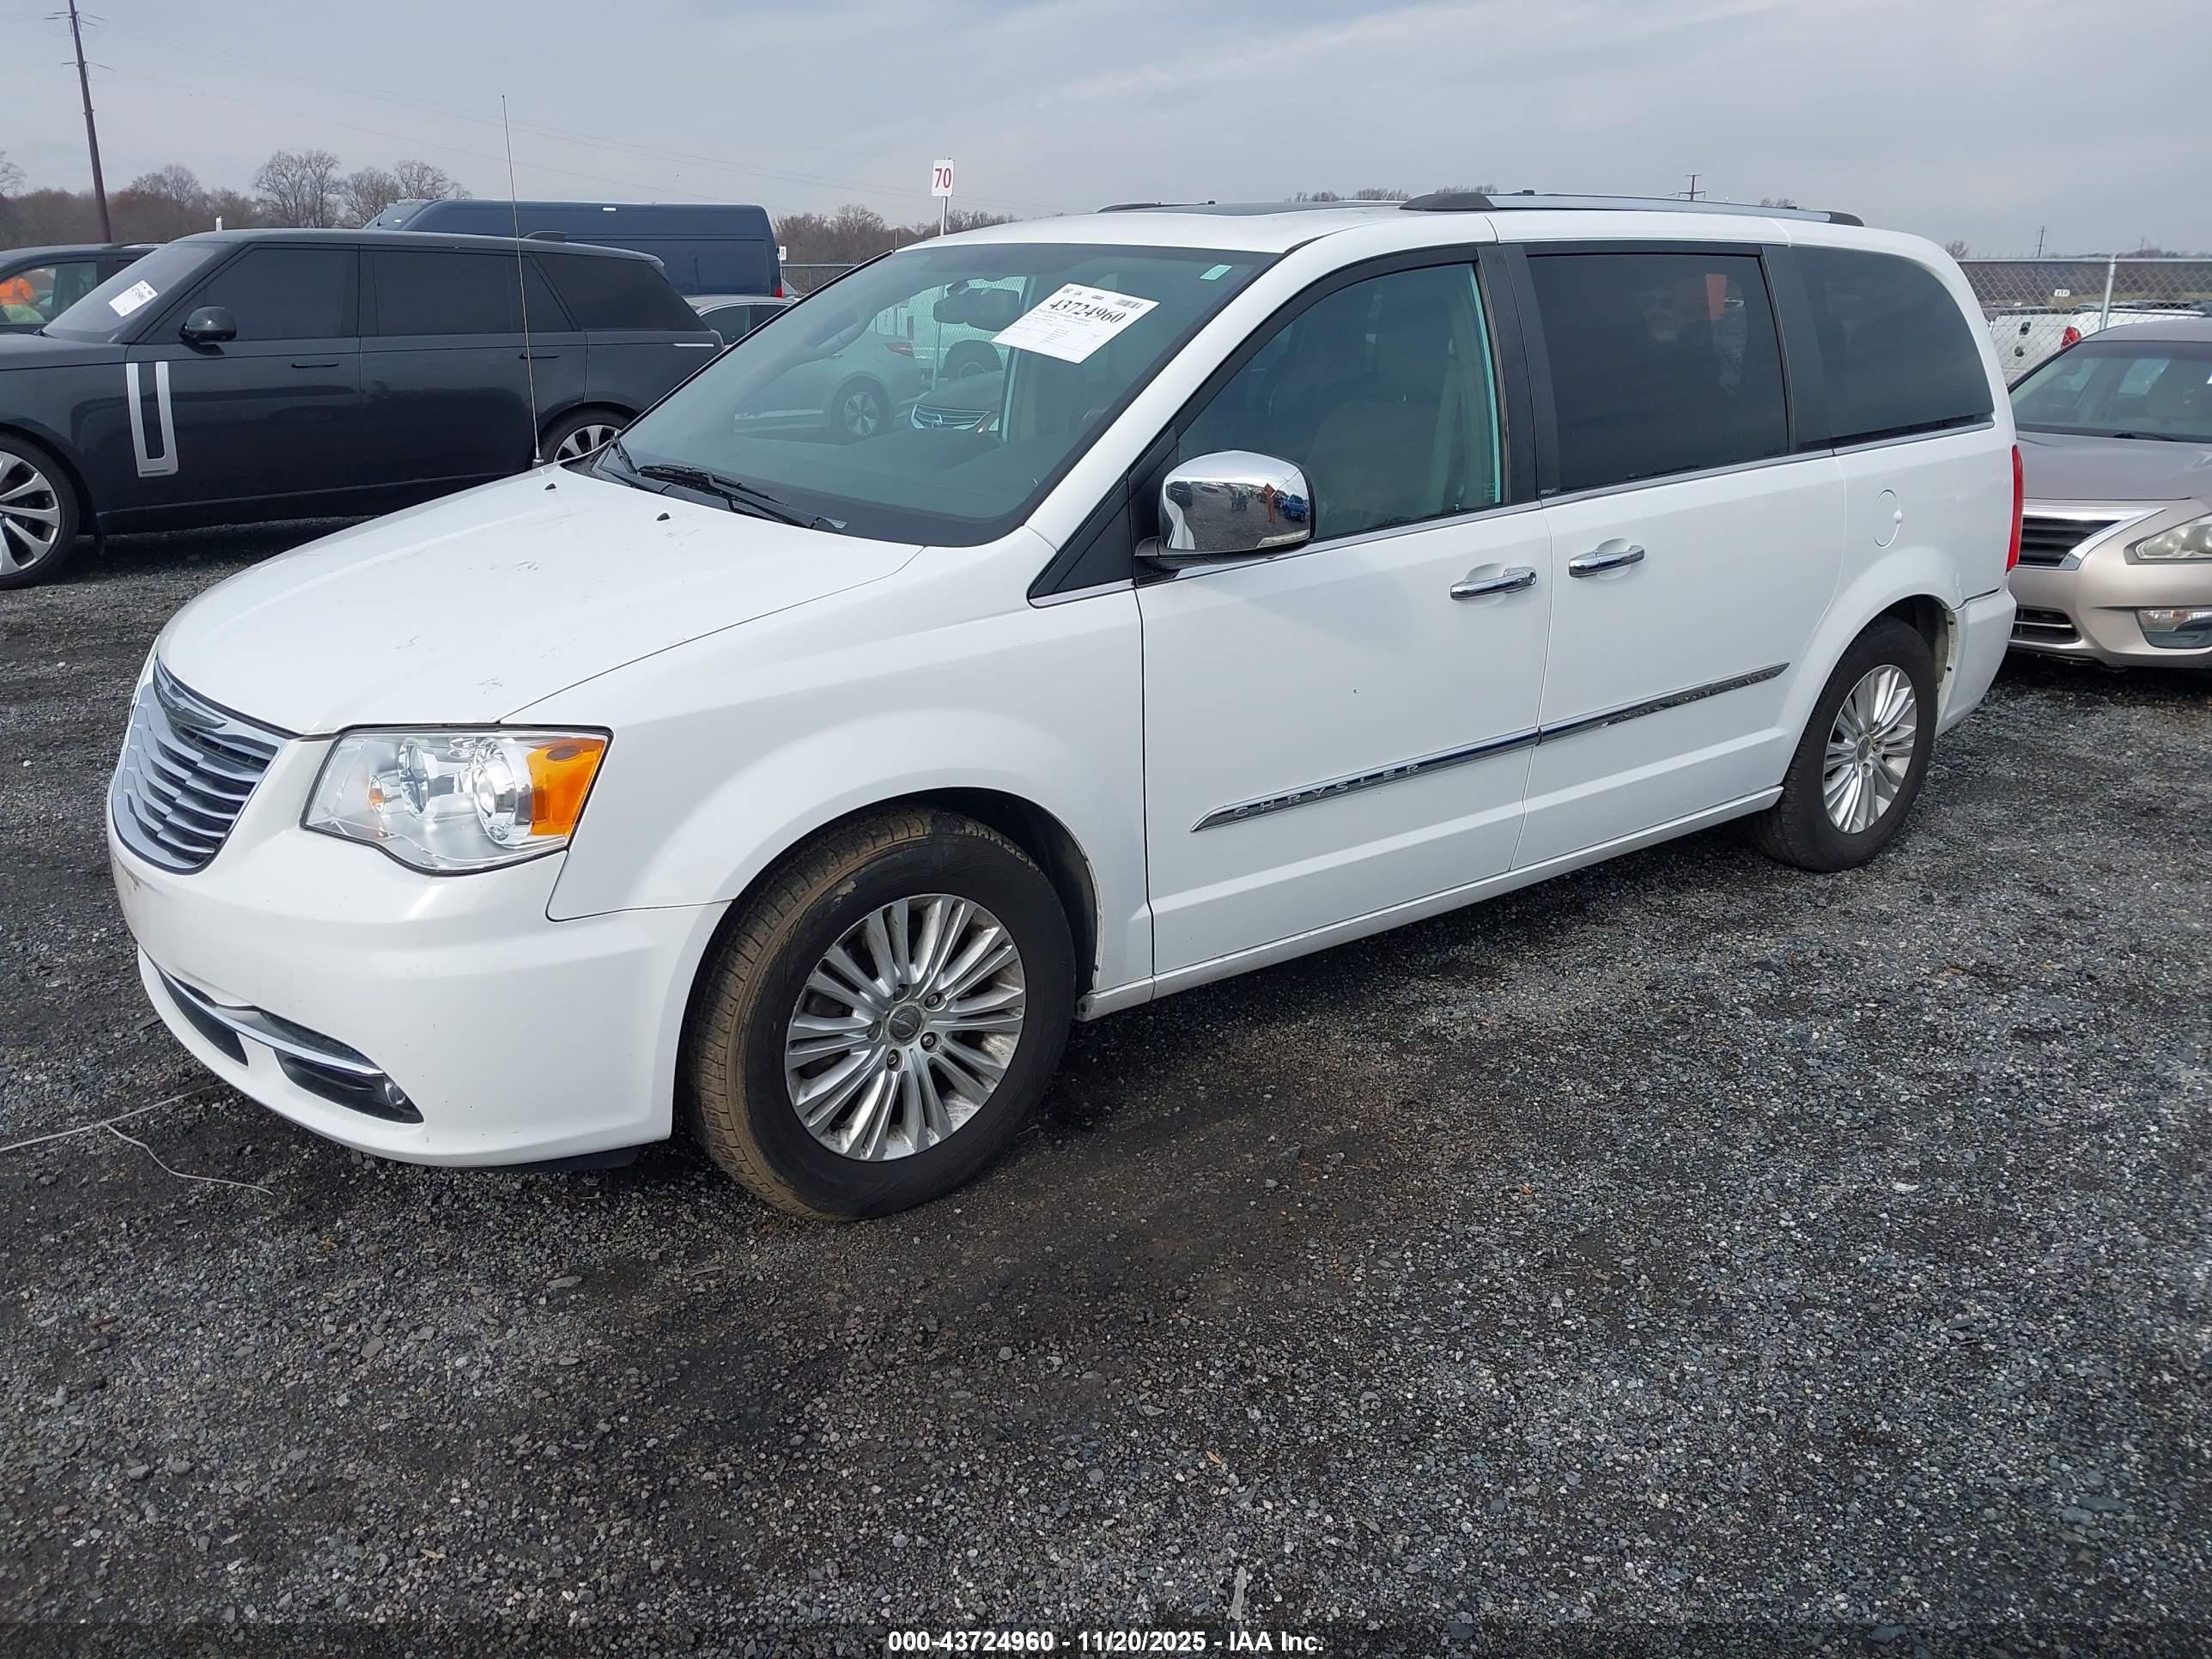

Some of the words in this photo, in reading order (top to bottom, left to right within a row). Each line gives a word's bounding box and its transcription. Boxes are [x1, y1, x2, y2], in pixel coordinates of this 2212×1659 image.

[934, 167, 951, 189] 70
[1049, 300, 1127, 324] 43724960
[1235, 764, 1419, 817] CHRYSLER
